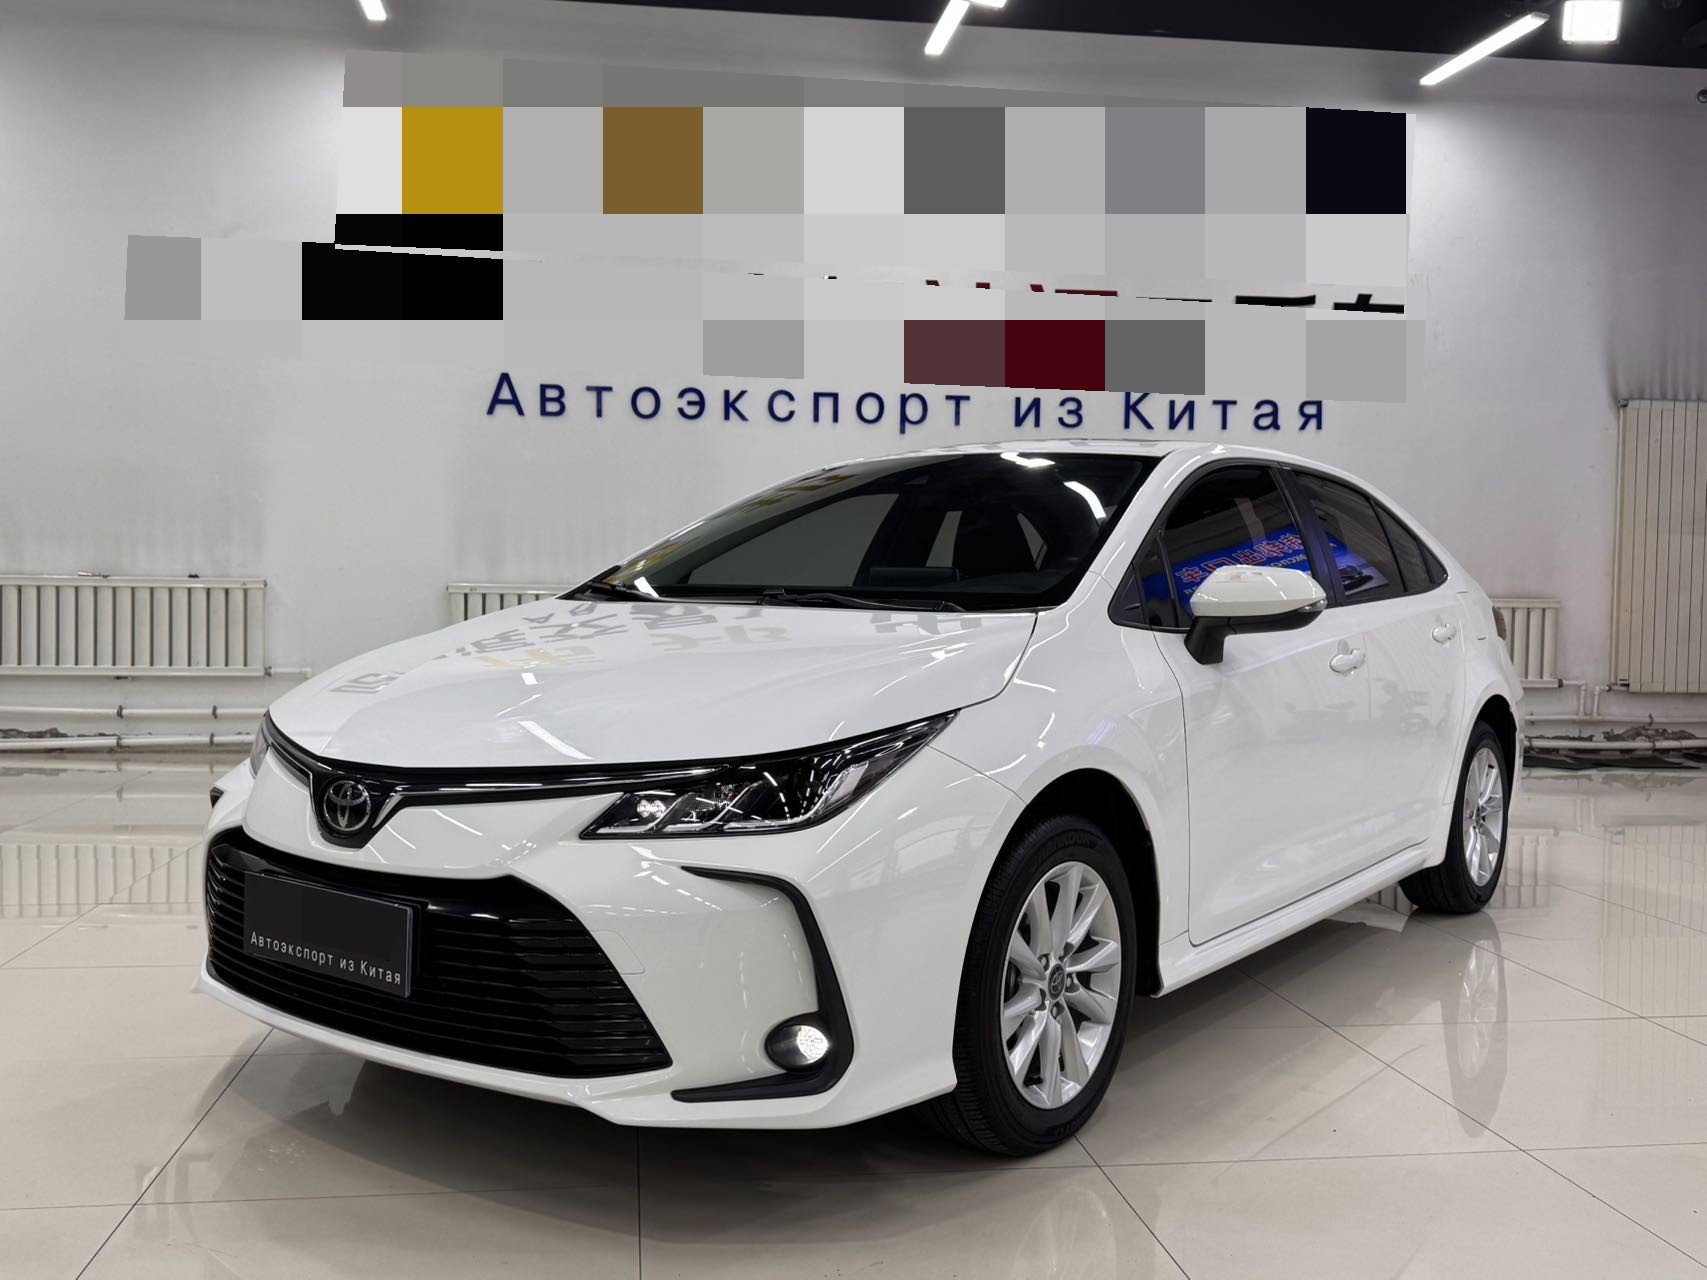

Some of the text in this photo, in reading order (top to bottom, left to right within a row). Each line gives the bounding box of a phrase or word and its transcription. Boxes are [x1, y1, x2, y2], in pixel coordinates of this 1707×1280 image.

[486, 372, 1324, 434] Автоэкспорт из Китая
[250, 931, 401, 985] Автоэкспорт из Китая
